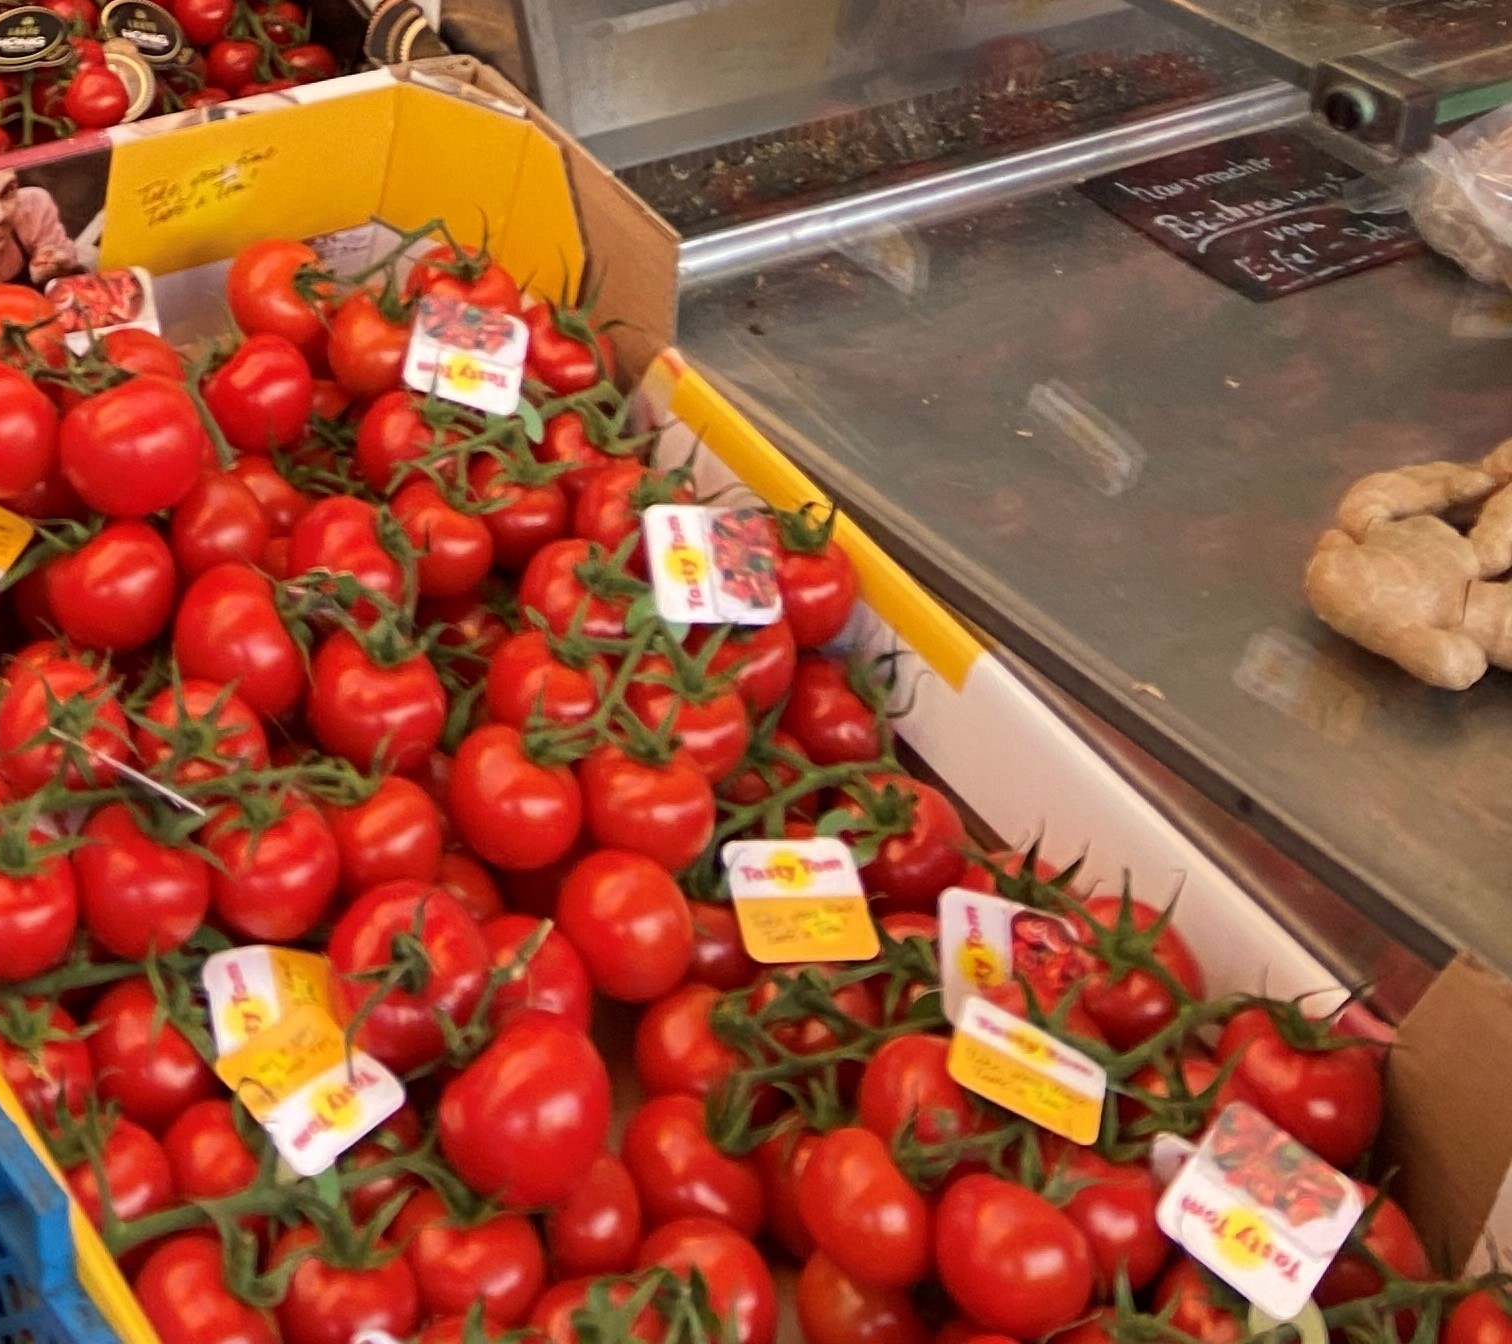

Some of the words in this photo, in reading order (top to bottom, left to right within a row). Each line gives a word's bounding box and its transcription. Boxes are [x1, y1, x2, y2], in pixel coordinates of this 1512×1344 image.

[740, 855, 798, 884] Tasty
[796, 856, 844, 879] Tom
[1180, 1194, 1229, 1239] Tom
[1234, 1225, 1302, 1281] Tasty
